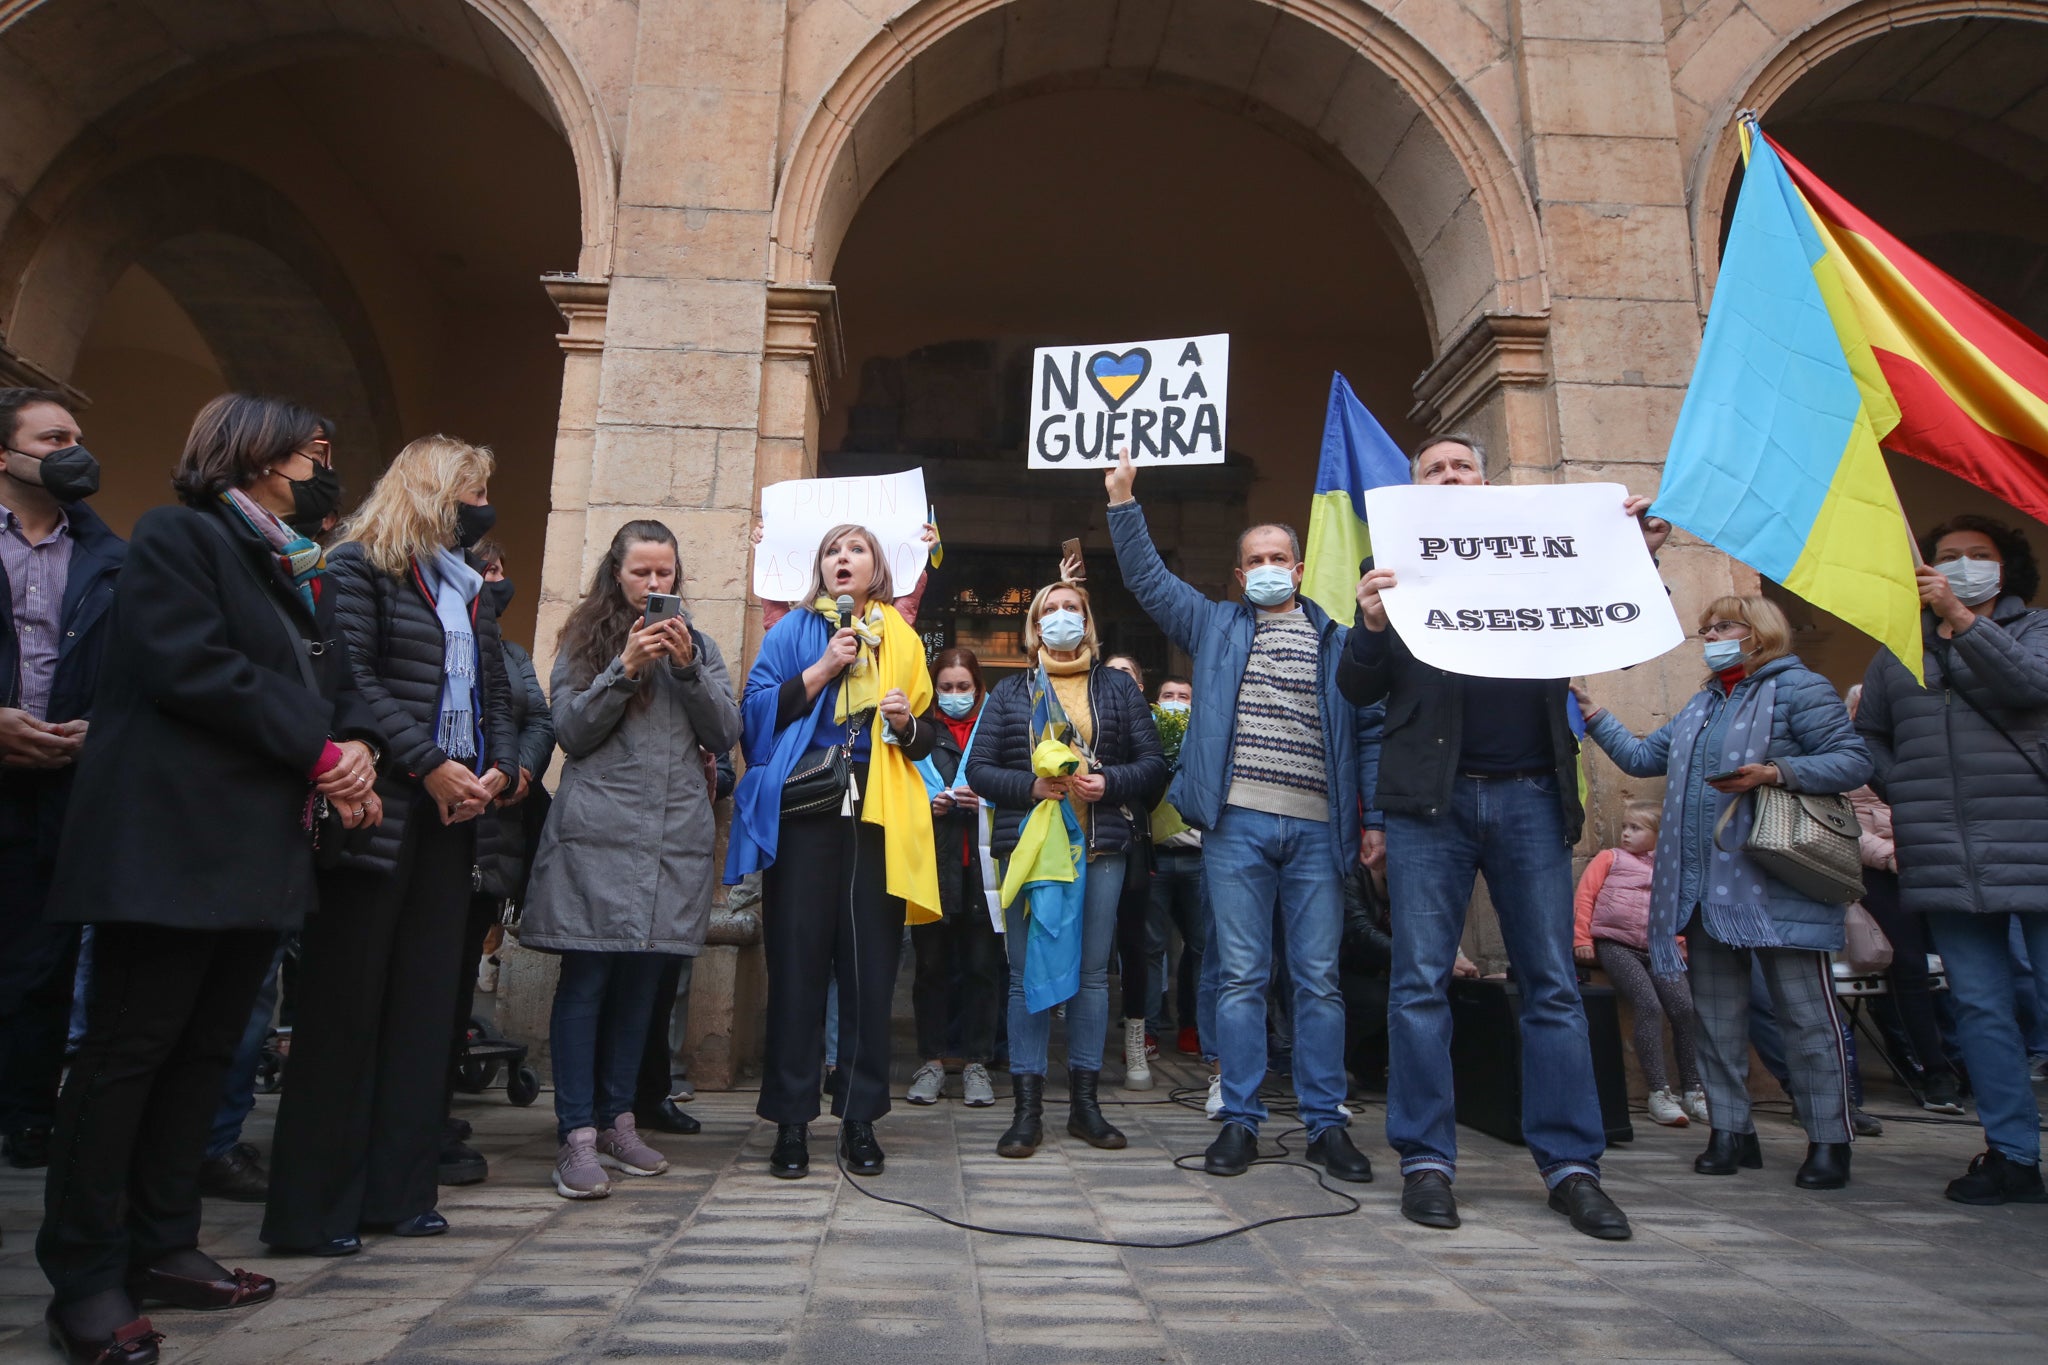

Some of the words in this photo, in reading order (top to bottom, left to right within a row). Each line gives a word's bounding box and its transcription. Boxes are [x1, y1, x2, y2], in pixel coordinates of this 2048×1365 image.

[1178, 341, 1203, 367] A
[1160, 371, 1208, 402] LA
[1036, 403, 1223, 462] GUERRA
[792, 477, 897, 521] PUTIN
[1419, 535, 1578, 560] PUTIN
[1424, 602, 1641, 631] ASESINO
